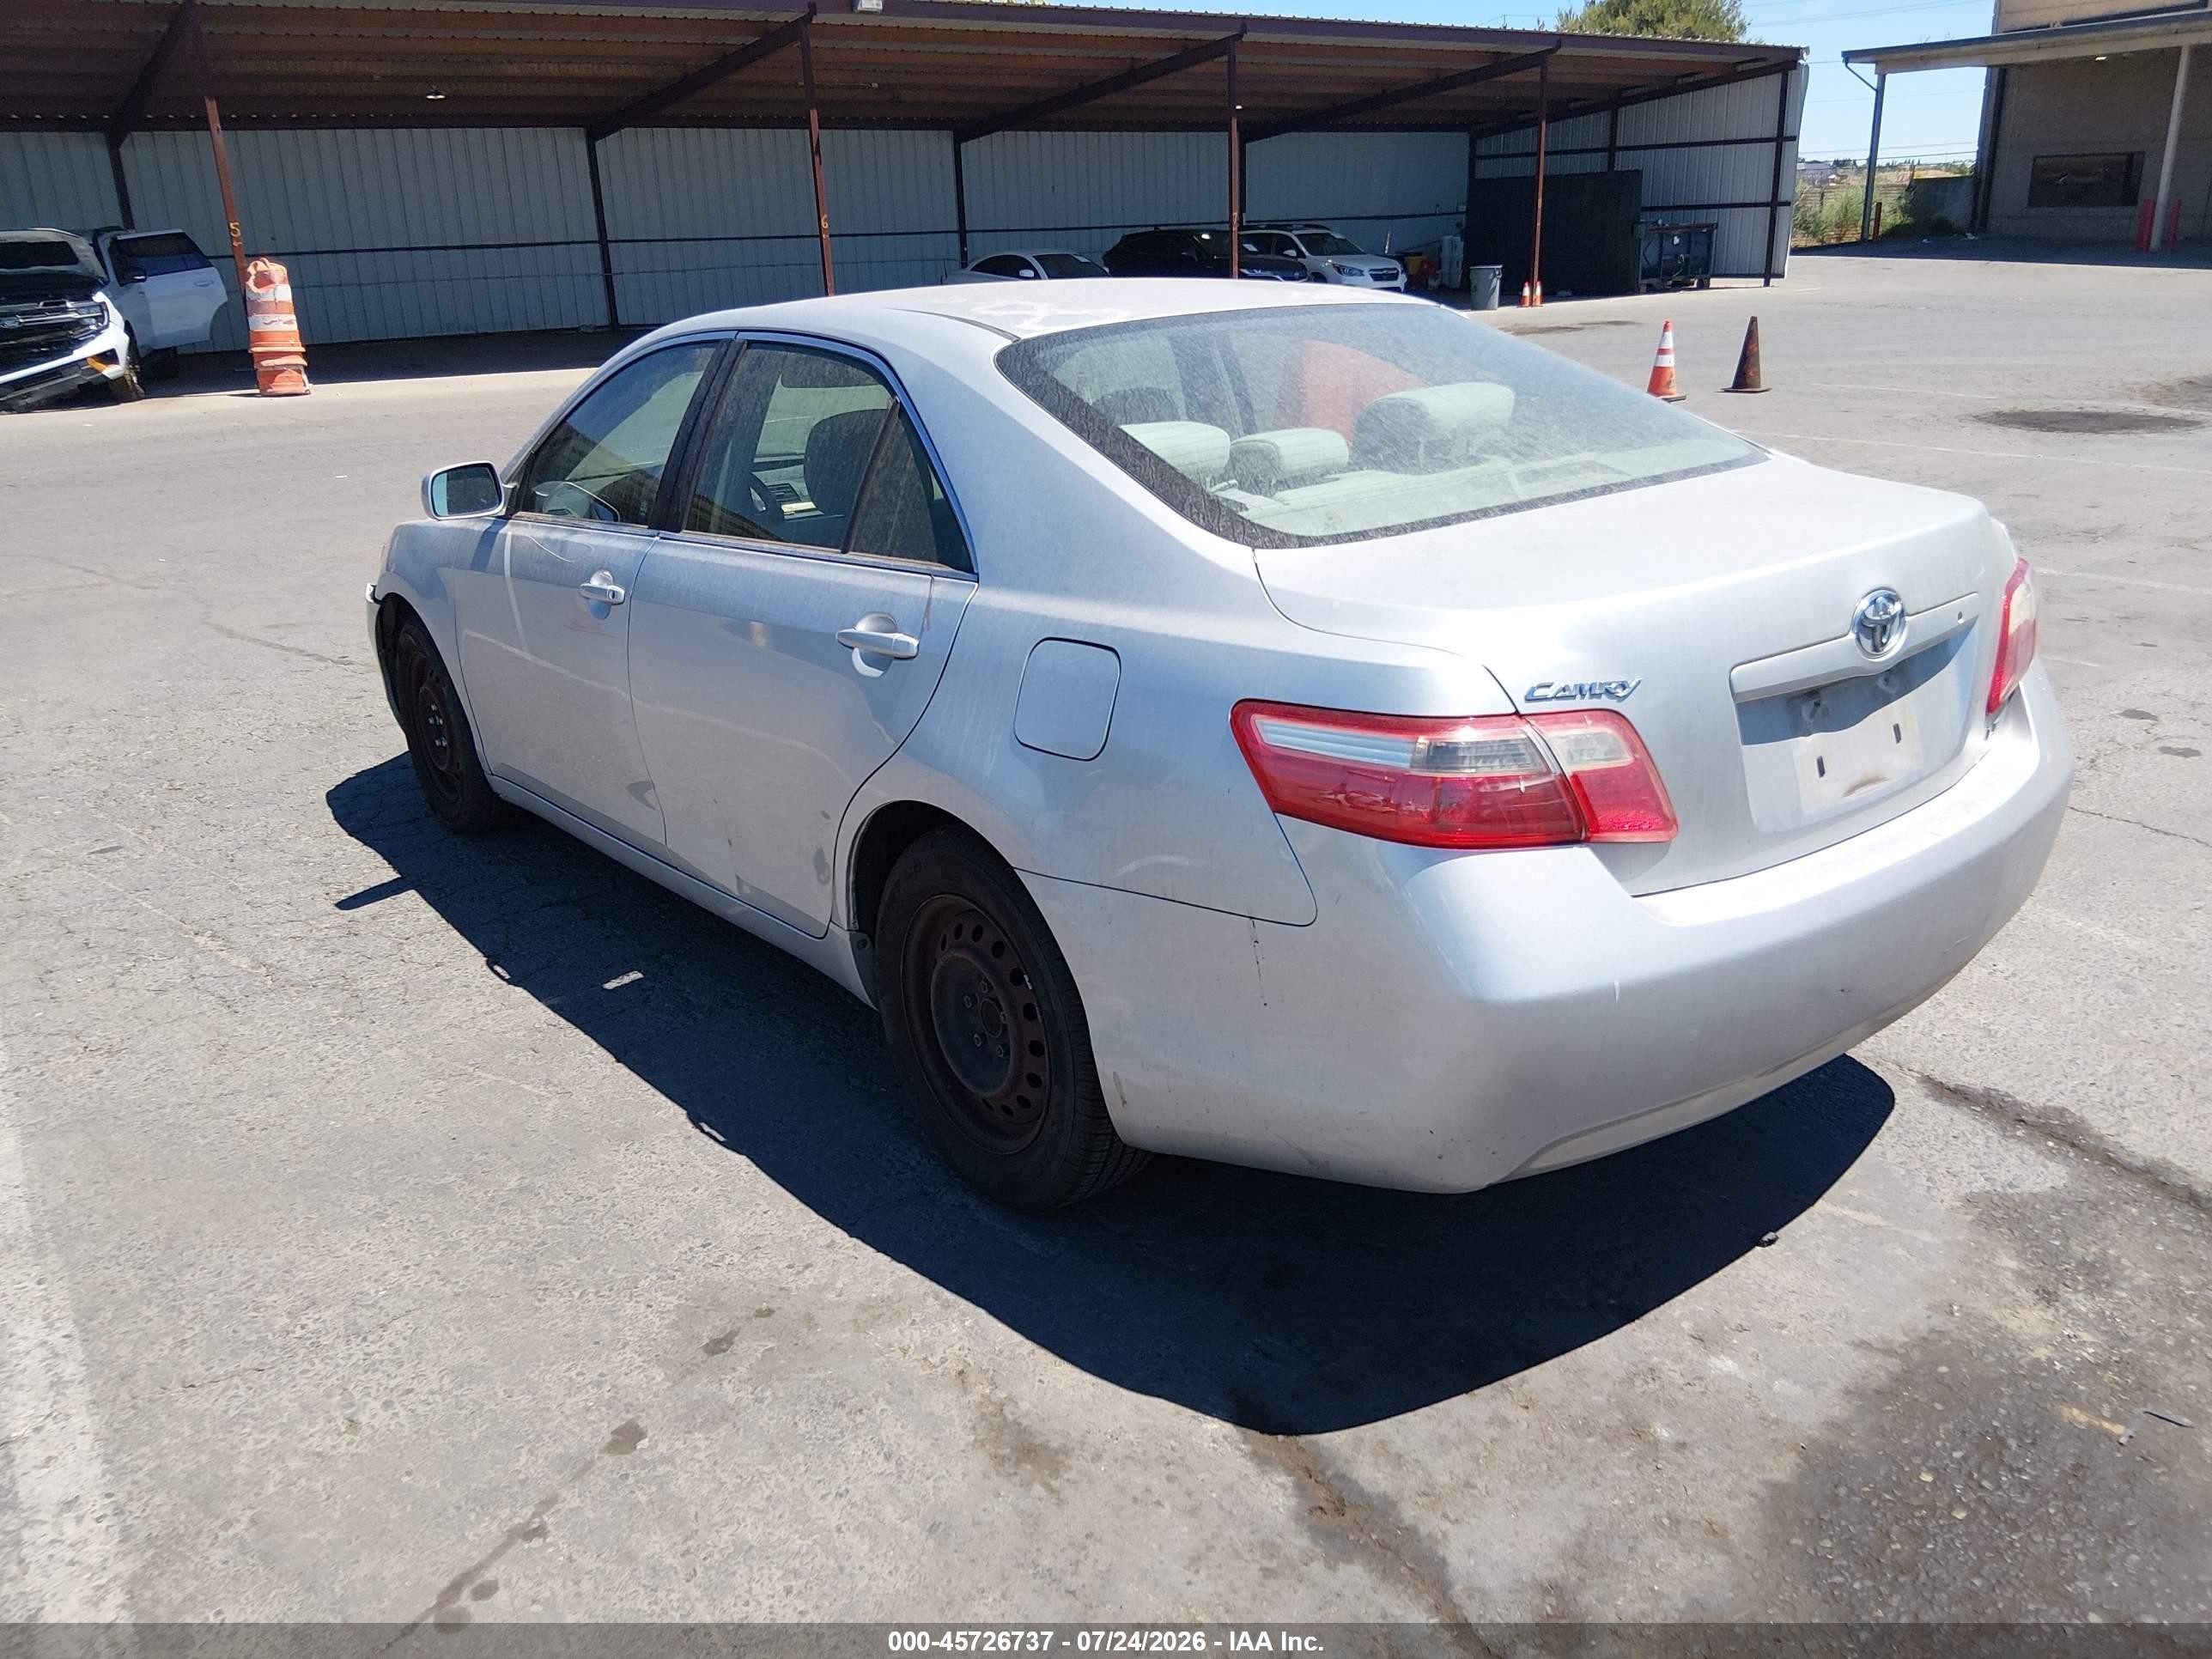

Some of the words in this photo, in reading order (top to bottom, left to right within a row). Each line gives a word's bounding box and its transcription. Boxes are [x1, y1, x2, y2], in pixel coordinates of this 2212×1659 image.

[821, 214, 830, 229] 6
[229, 222, 241, 237] 5
[1524, 678, 1643, 702] CAMRY
